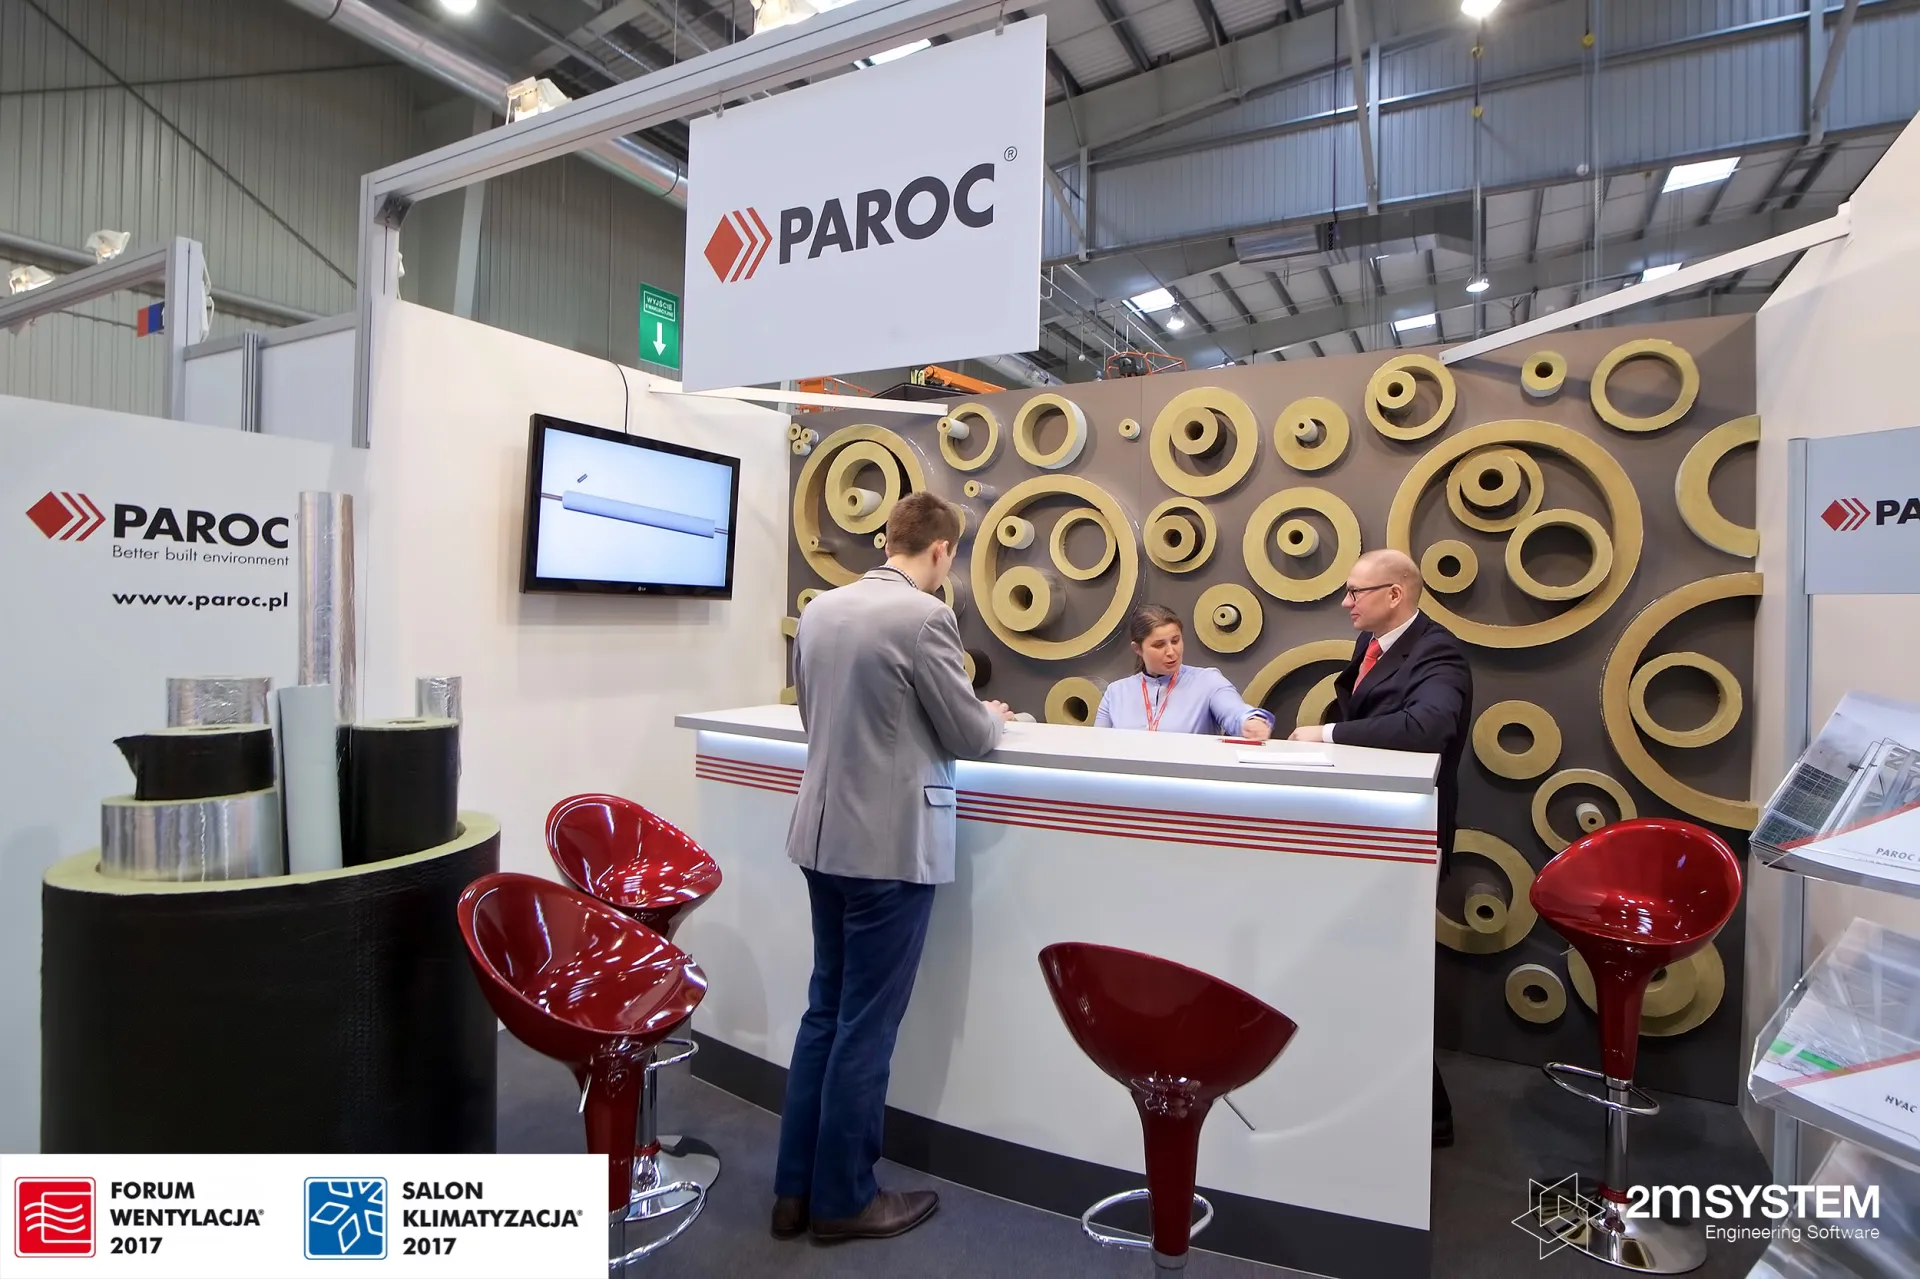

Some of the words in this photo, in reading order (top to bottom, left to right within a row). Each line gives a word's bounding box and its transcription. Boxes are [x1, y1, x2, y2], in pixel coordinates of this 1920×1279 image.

[113, 503, 289, 549] PAROC
[112, 545, 160, 560] Better
[165, 547, 198, 562] built
[202, 551, 289, 566] environment
[112, 591, 289, 612] www.paroc.pl
[1876, 847, 1915, 861] PAROC
[1885, 1095, 1918, 1113] HVAC
